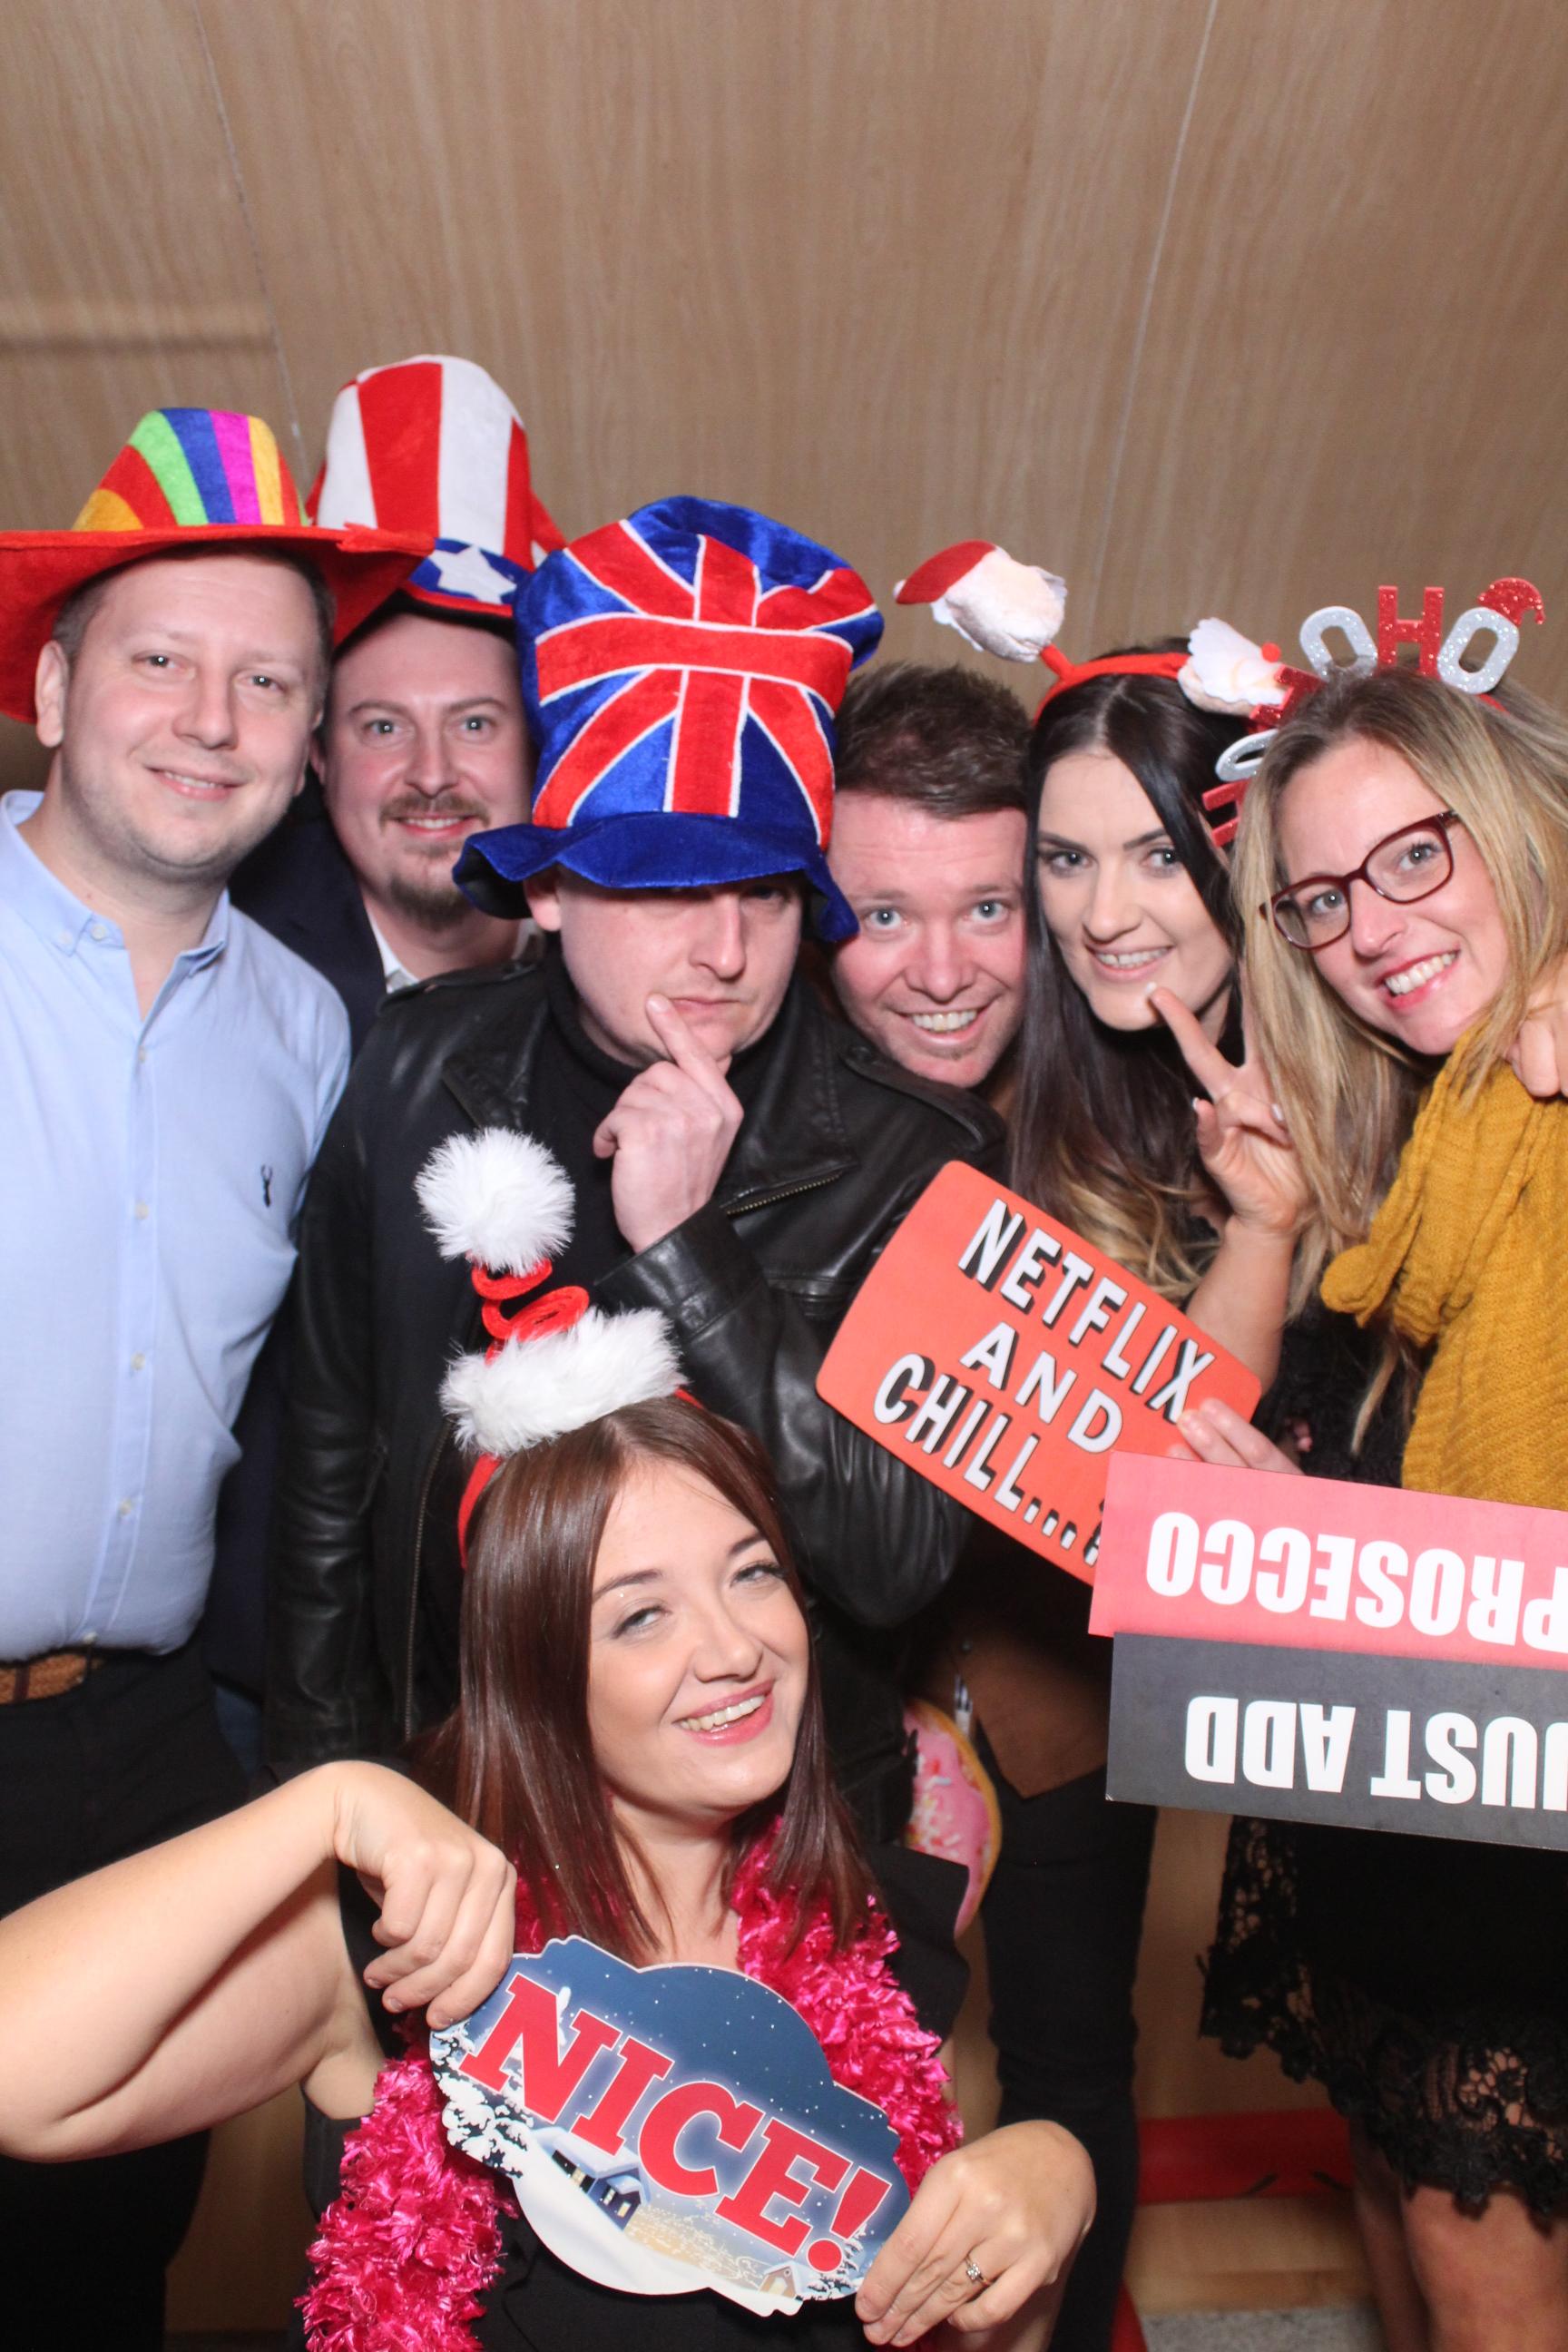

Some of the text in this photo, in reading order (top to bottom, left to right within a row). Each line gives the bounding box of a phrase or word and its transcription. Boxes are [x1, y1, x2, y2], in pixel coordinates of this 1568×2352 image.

[958, 1197, 1216, 1426] NETFLIX
[959, 1321, 1124, 1455] AND
[1145, 1511, 1568, 1655] PROSECCO
[1184, 1695, 1357, 1793] ADD
[457, 1971, 893, 2274] NICE!
